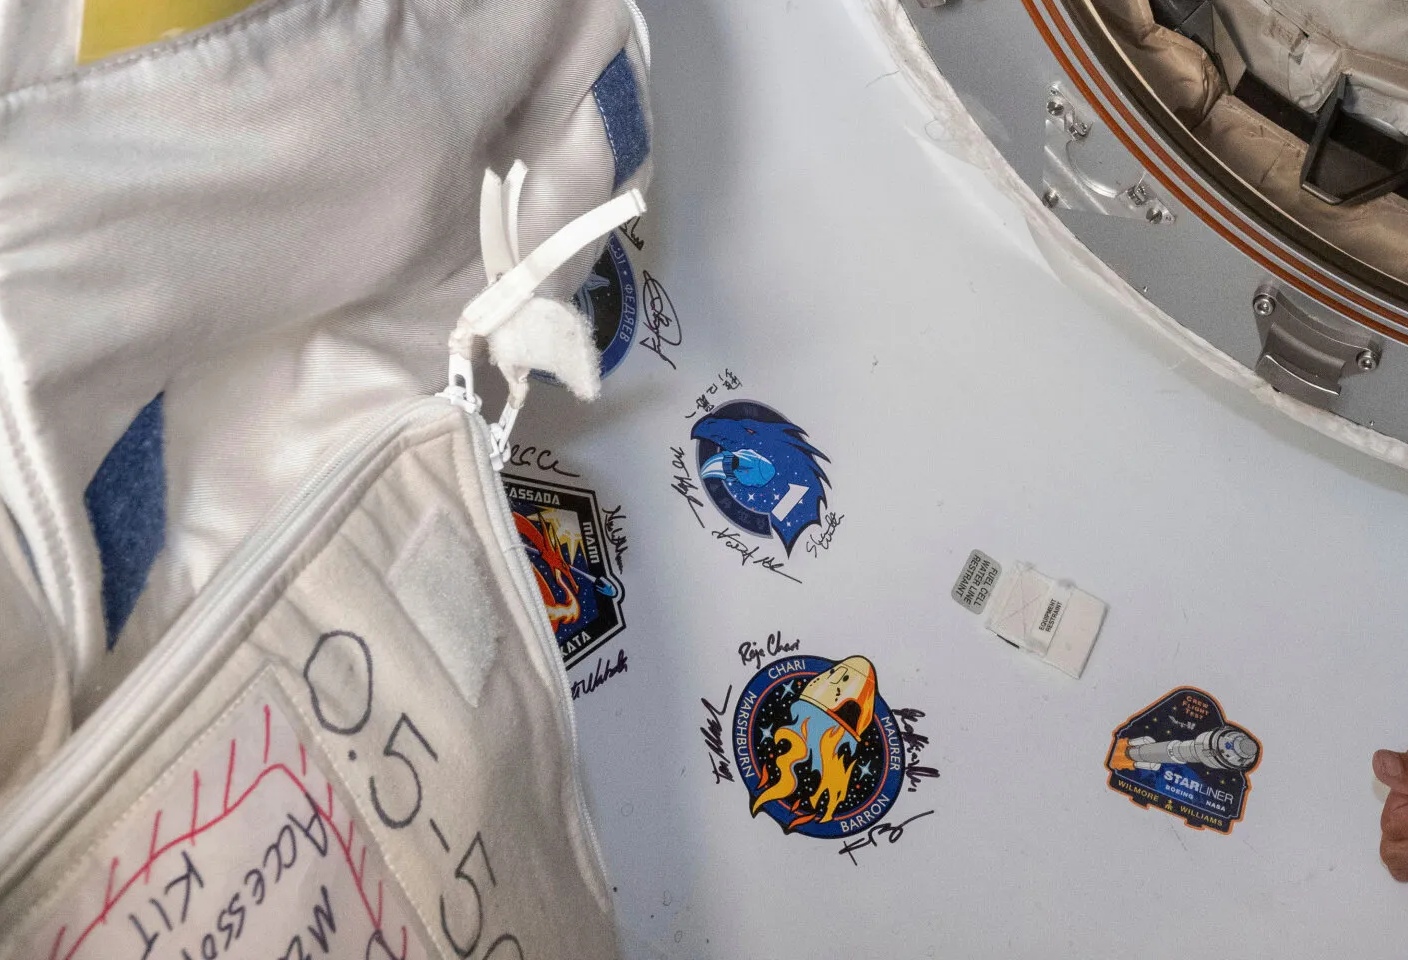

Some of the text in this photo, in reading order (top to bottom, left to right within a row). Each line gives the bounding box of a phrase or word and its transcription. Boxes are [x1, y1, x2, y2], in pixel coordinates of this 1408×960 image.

[619, 283, 636, 343] ФЕДЯЕВ
[582, 521, 600, 564] MANN
[955, 555, 981, 597] RESTRAINT
[963, 559, 991, 605] WATER LINE
[973, 567, 998, 607] FUEL CELL
[1038, 598, 1056, 631] EQUIPMENT
[1045, 601, 1062, 633] RESTRAINT
[559, 631, 592, 658] KATA
[768, 660, 806, 680] CHARI
[1182, 700, 1209, 716] FLIGHT
[1186, 695, 1209, 709] CREW
[736, 690, 758, 778] MARSHBURN
[881, 716, 901, 771] MAURER
[1118, 779, 1223, 827] WILMORE WILLIAMS
[1164, 770, 1235, 804] STARLINER
[1165, 785, 1226, 812] BOEING NASA
[840, 794, 890, 833] BARRON
[128, 850, 204, 960] KIT
